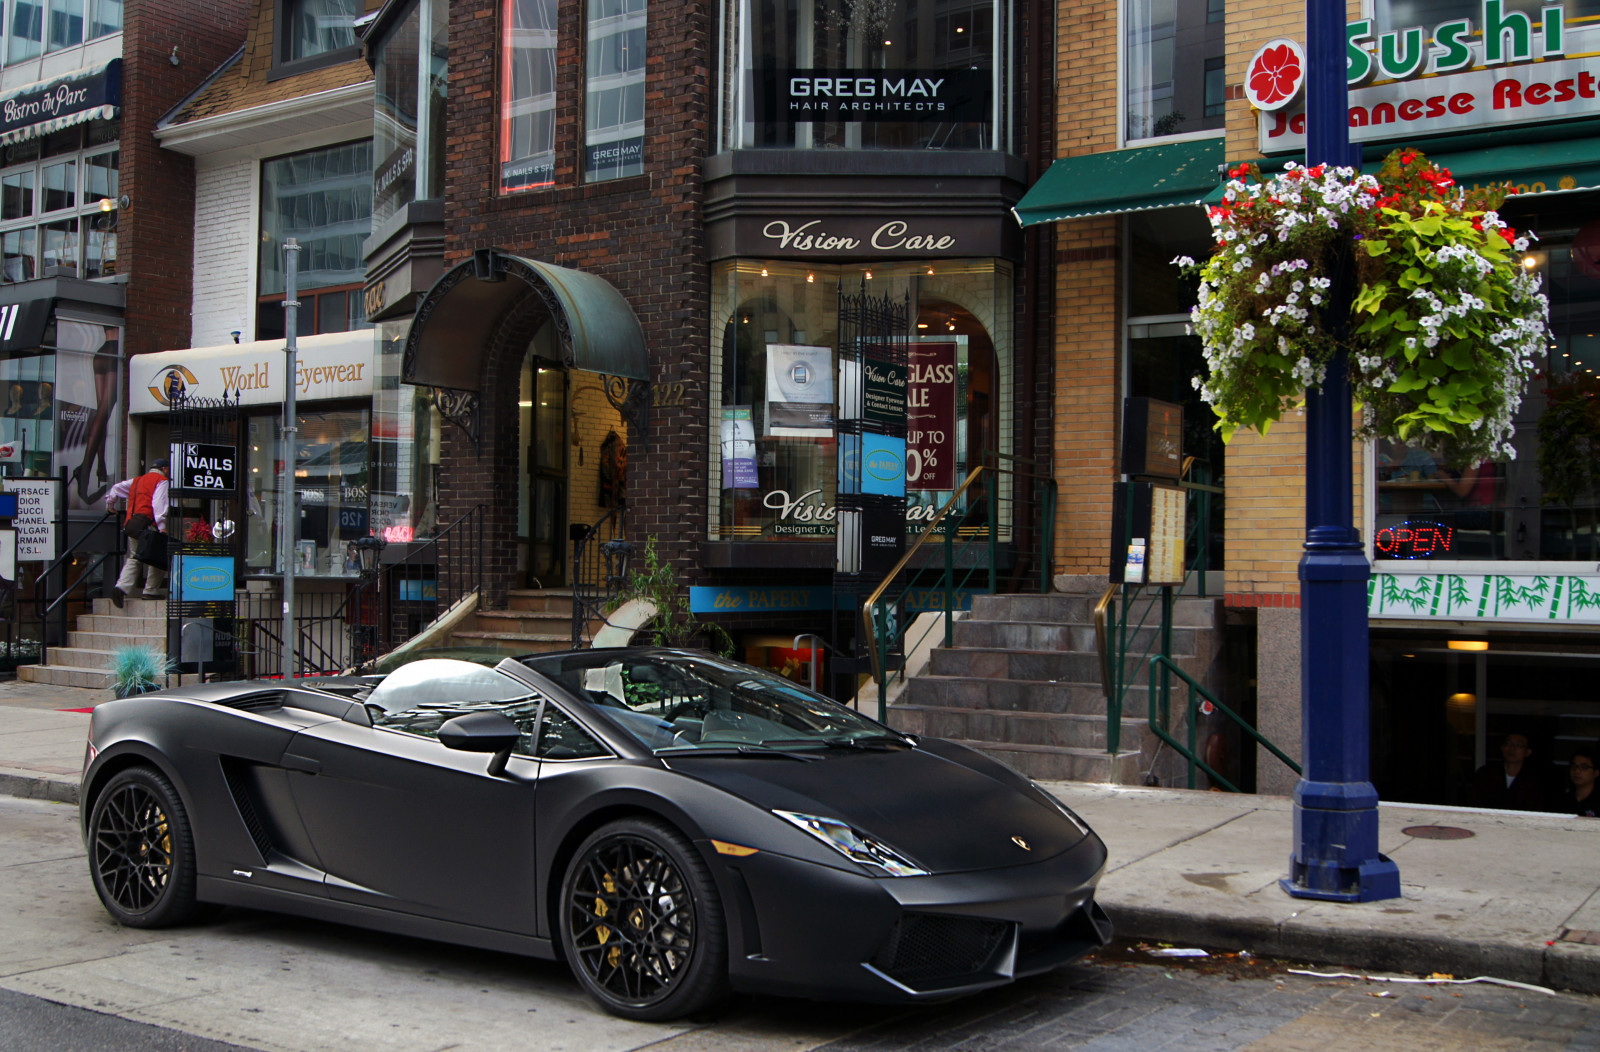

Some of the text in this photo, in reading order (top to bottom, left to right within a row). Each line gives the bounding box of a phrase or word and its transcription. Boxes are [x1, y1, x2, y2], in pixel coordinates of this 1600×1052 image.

[790, 77, 945, 97] GREG MAY
[4, 99, 39, 123] Bistro
[53, 84, 88, 116] Parc
[790, 102, 945, 111] HAIR ARCHITECTS
[1268, 71, 1600, 138] Jaanese Rest
[593, 144, 641, 160] GREG MAY
[401, 147, 413, 173] SPA
[512, 166, 533, 176] NAILS
[540, 163, 554, 172] SPA
[763, 220, 956, 251] Vision Care
[220, 360, 365, 393] World Eyewear
[864, 365, 906, 388] Vision Care
[650, 383, 685, 407] 122
[866, 392, 886, 403] Designer
[872, 401, 888, 410] Contact
[888, 404, 904, 412] Lenses
[907, 430, 945, 445] UP TO
[188, 445, 197, 455] K
[186, 456, 232, 471] NAILS
[194, 475, 225, 488] SPA
[923, 472, 936, 480] OFF
[10, 487, 50, 495] VERSACE
[763, 488, 836, 523] Visio
[775, 525, 817, 537] Designer
[1376, 528, 1453, 553] OPEN
[19, 546, 42, 554] Y.S.L.
[713, 590, 743, 608] the
[748, 590, 813, 608] PAPERY
